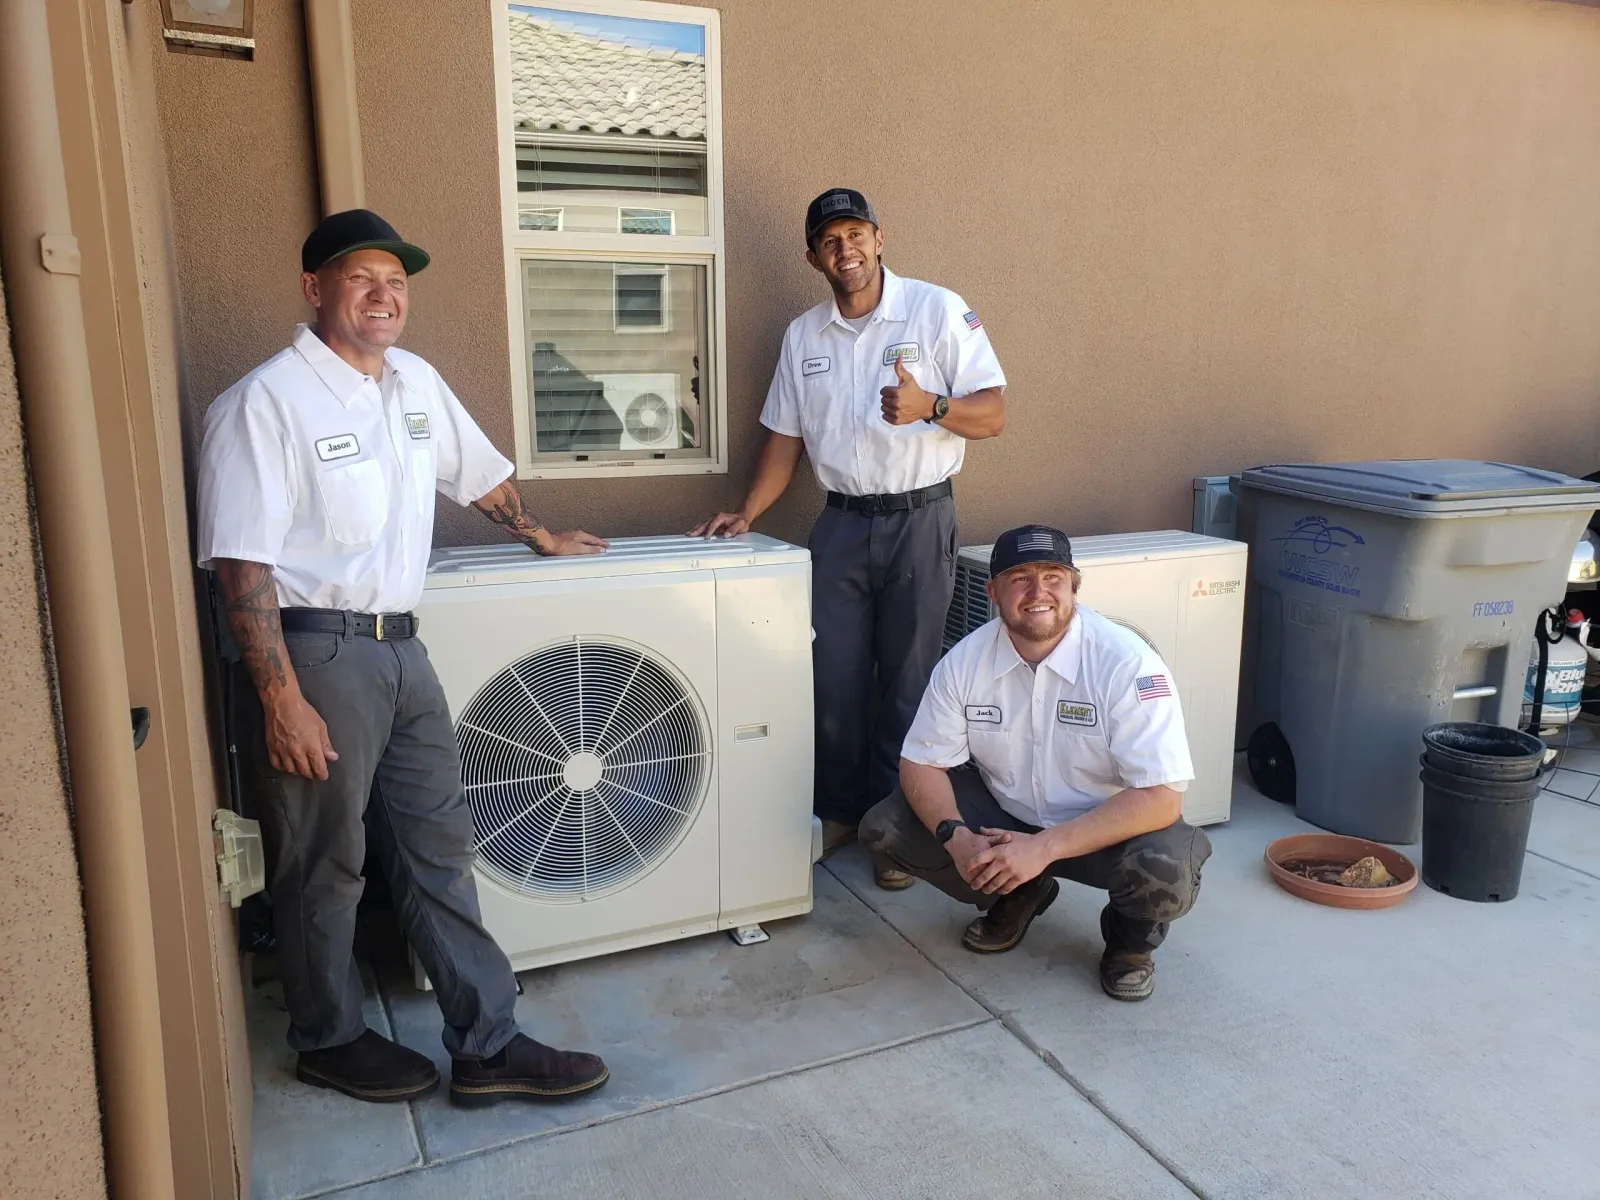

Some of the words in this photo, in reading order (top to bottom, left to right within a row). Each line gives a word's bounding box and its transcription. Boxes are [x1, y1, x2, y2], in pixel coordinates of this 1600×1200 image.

[807, 361, 822, 369] Drew
[327, 441, 352, 452] Jason
[1283, 549, 1360, 587] WCSW
[1209, 580, 1241, 589] MITSUBISHI
[1209, 587, 1236, 596] ELECTRIC
[1560, 669, 1586, 681] Blu
[1059, 702, 1094, 717] ELEMENT
